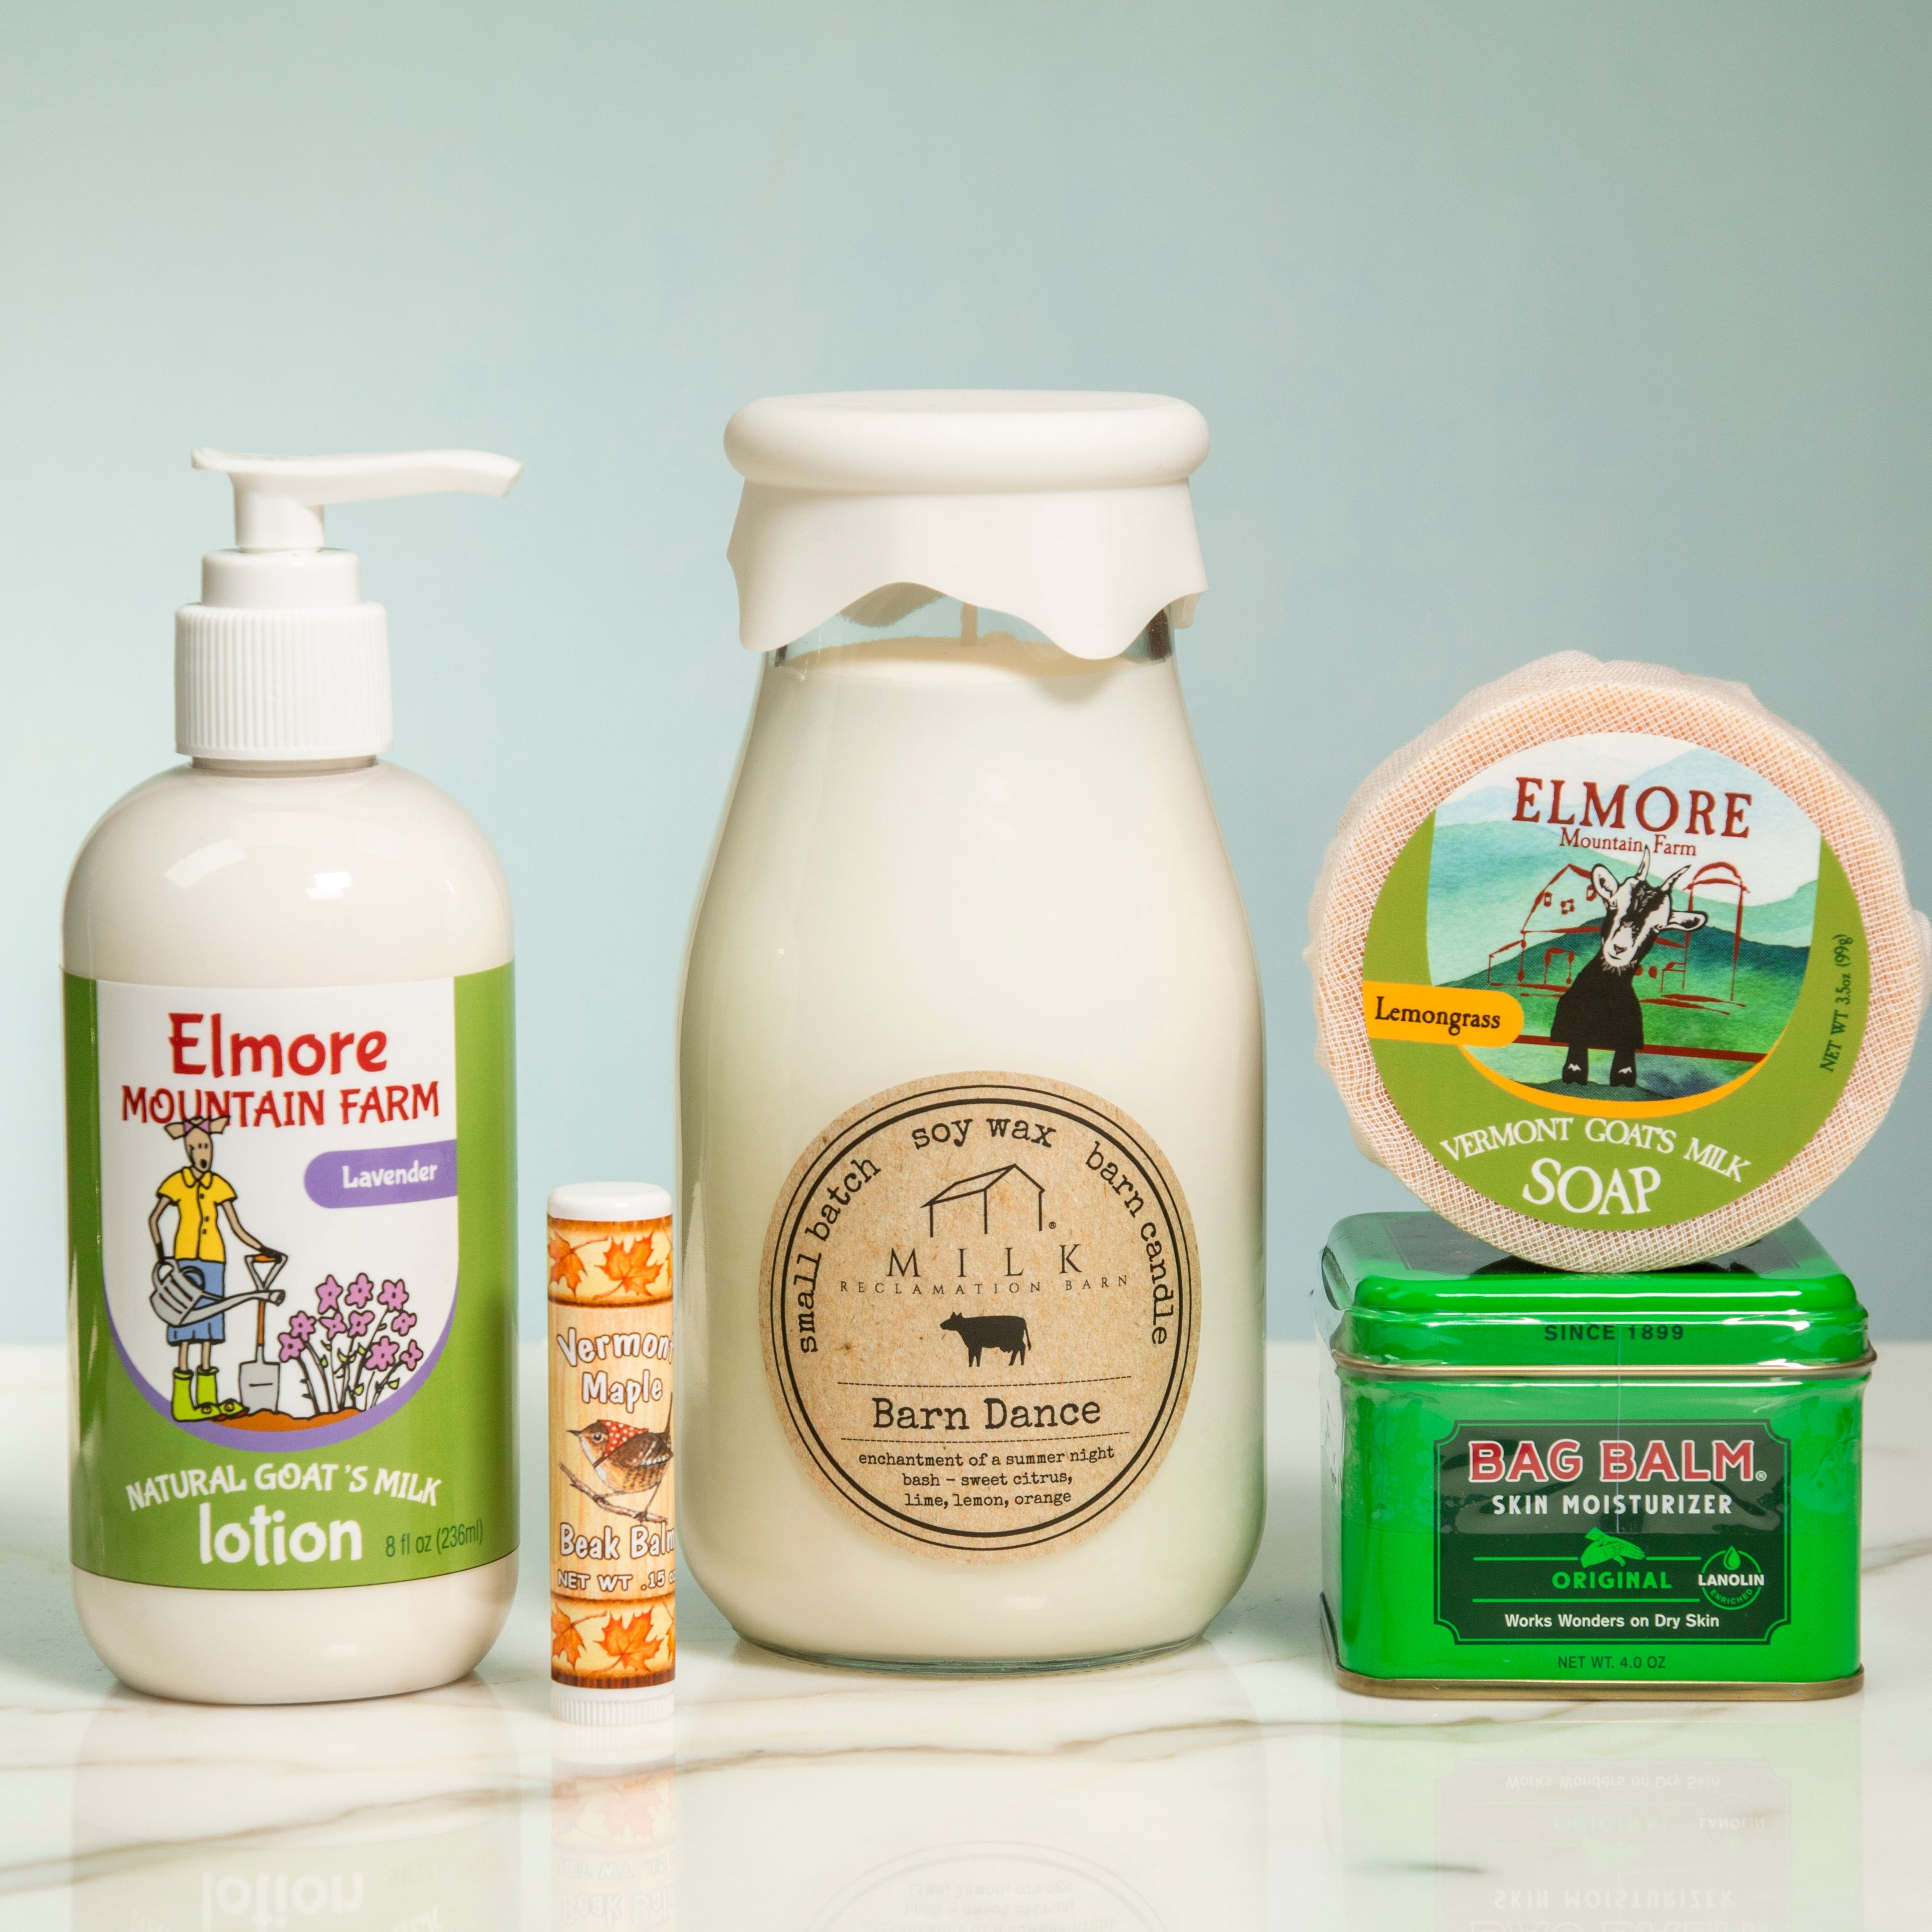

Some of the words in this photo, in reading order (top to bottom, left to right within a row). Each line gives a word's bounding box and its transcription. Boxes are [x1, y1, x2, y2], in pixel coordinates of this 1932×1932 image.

[1512, 776, 1752, 838] ELMORE
[1560, 827, 1644, 852] Mountain
[1653, 834, 1697, 856] Farm
[1832, 934, 1854, 967] (99g)
[1835, 973, 1852, 1005] 3.5oz
[1374, 995, 1501, 1036] Lemongrass
[1830, 1009, 1848, 1035] WT
[168, 1012, 387, 1078] Elmore
[1819, 1039, 1842, 1073] NET
[121, 1085, 325, 1128] MOUNTAIN
[340, 1081, 439, 1124] FARM
[911, 1118, 973, 1150] soy
[987, 1118, 1057, 1148] wax
[1439, 1117, 1574, 1161] VERMONT
[1683, 1137, 1752, 1183] MILK
[342, 1162, 438, 1189] Lavender
[1522, 1157, 1661, 1215] SOAP
[806, 1156, 881, 1243] batch
[1084, 1141, 1146, 1218] barn
[1140, 1221, 1174, 1346] candle
[886, 1243, 1082, 1278] MILK
[840, 1280, 1040, 1295] RECLAMATION
[1065, 1274, 1129, 1291] BARN
[793, 1252, 823, 1353] small
[1544, 1324, 1616, 1341] SINCE
[1628, 1324, 1684, 1340] 1899
[582, 1369, 662, 1413] Maple
[872, 1397, 970, 1430] Barn
[983, 1398, 1100, 1429] Dance
[859, 1453, 963, 1467] enchantment
[969, 1454, 988, 1467] of
[992, 1456, 1001, 1466] a
[1006, 1453, 1065, 1465] summer
[1070, 1446, 1114, 1463] night
[1468, 1439, 1583, 1483] BAG
[126, 1465, 247, 1511] NATURAL
[373, 1468, 442, 1506] MILK
[903, 1473, 940, 1486] bash
[961, 1474, 1008, 1486] sweet
[1013, 1472, 1073, 1486] citrus,
[905, 1493, 949, 1508] lime,
[953, 1493, 1009, 1509] lemon,
[1014, 1491, 1071, 1506] orange
[1492, 1495, 1548, 1515] SKIN
[1563, 1494, 1732, 1515] MOISTURIZER
[199, 1502, 362, 1566] lotion
[386, 1536, 395, 1557] 8
[400, 1533, 410, 1555] fl
[416, 1535, 432, 1553] oz
[437, 1518, 482, 1555] (236ml)
[560, 1522, 619, 1559] Beak
[557, 1569, 591, 1590] NET
[597, 1575, 632, 1592] WT
[641, 1569, 665, 1590] .15
[1552, 1571, 1672, 1590] ORIGINAL
[1698, 1574, 1764, 1586] LANOLIN
[1710, 1588, 1753, 1604] ENRICHED
[1505, 1614, 1552, 1628] Works
[1558, 1614, 1625, 1628] Wonders
[1630, 1617, 1649, 1628] on
[1655, 1614, 1680, 1629] Dry
[1685, 1613, 1719, 1627] Skin
[1558, 1656, 1586, 1669] NET
[1591, 1656, 1614, 1669] WT.
[1620, 1656, 1642, 1669] 4.0
[1647, 1656, 1666, 1669] OZ
